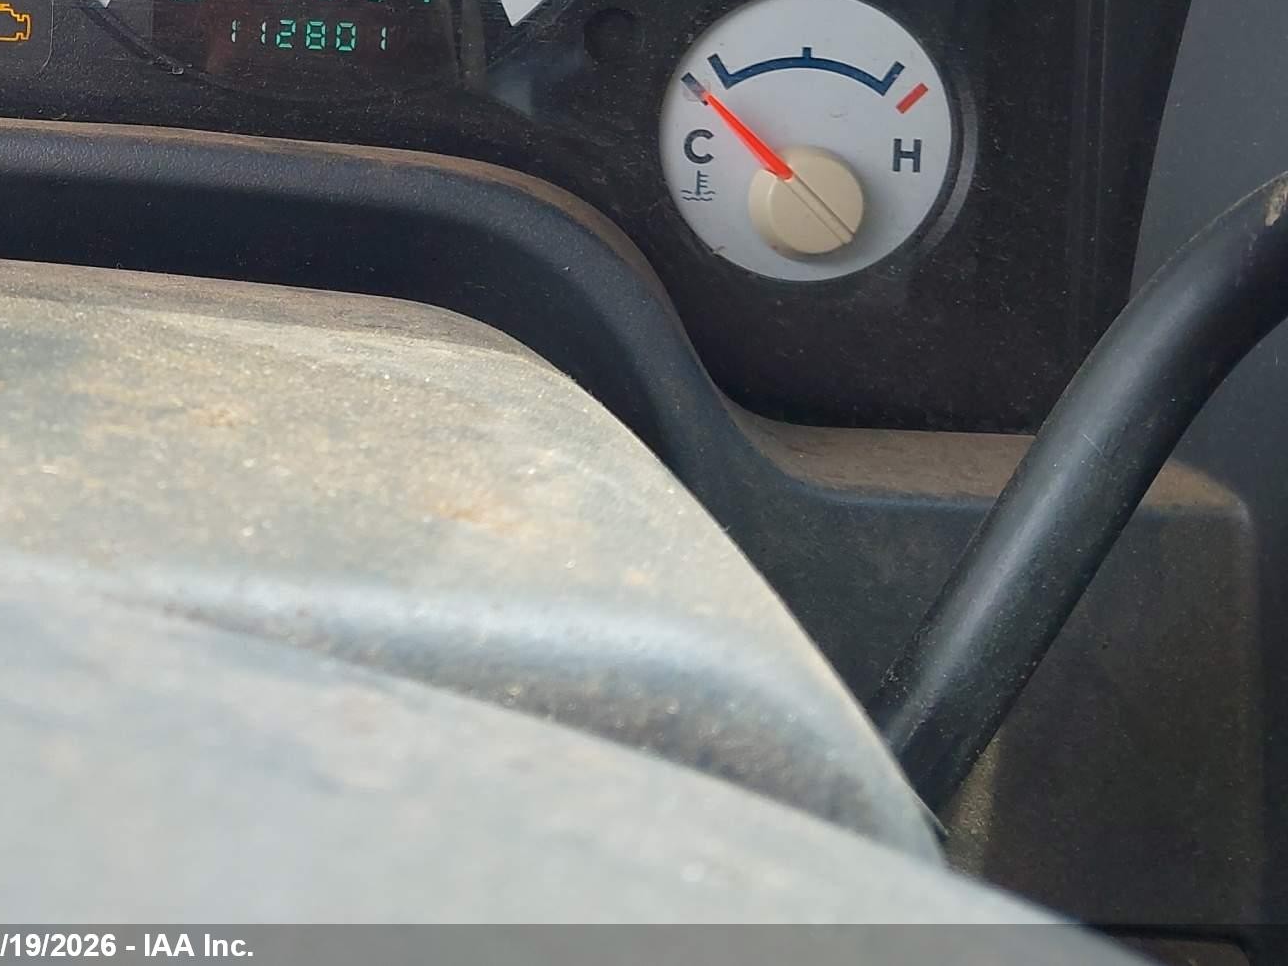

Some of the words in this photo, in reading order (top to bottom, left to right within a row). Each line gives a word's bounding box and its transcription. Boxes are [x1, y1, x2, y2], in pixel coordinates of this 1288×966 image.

[231, 19, 387, 51] 112801
[684, 129, 714, 164] C
[893, 139, 921, 172] H
